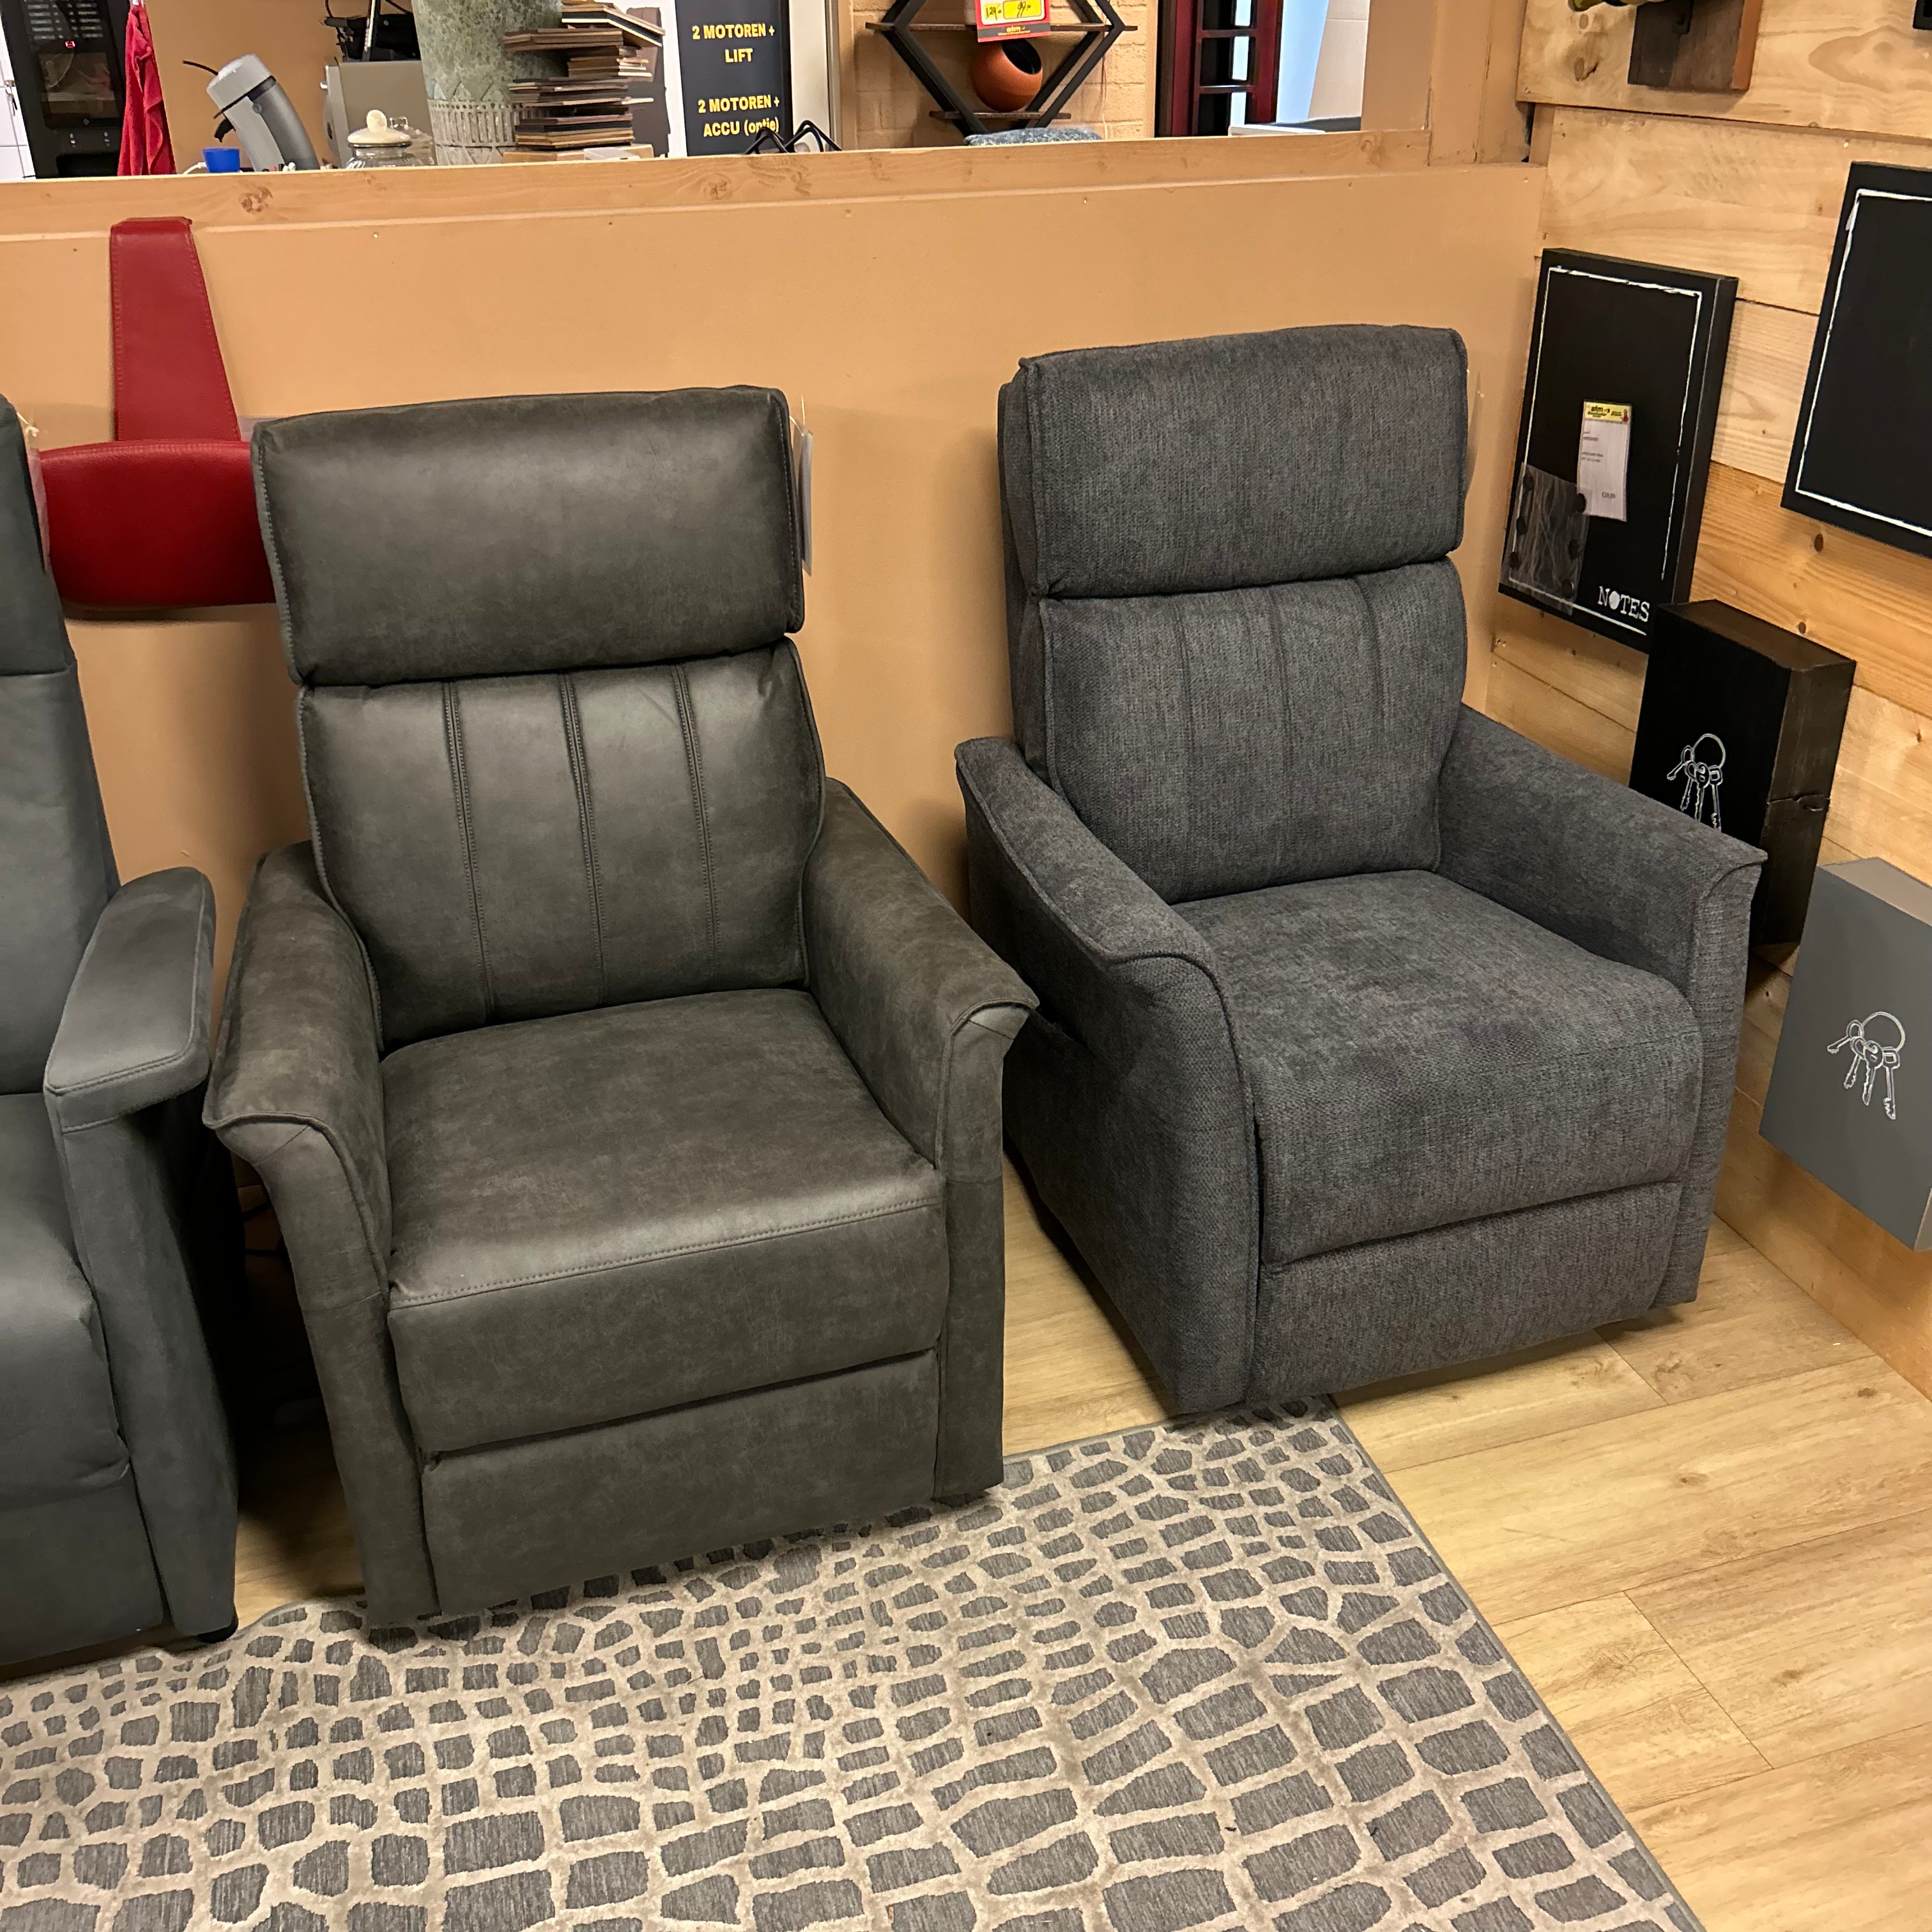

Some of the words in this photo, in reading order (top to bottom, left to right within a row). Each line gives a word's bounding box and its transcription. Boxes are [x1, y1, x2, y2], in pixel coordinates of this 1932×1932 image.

[692, 26, 700, 40] 2
[703, 24, 766, 39] MOTOREN
[769, 26, 775, 36] +
[724, 48, 753, 63] LIFT
[698, 100, 706, 113] 2
[709, 95, 772, 112] MOTOREN
[774, 96, 780, 107] +
[703, 121, 740, 137] ACCU
[1597, 586, 1650, 622] NOTES
